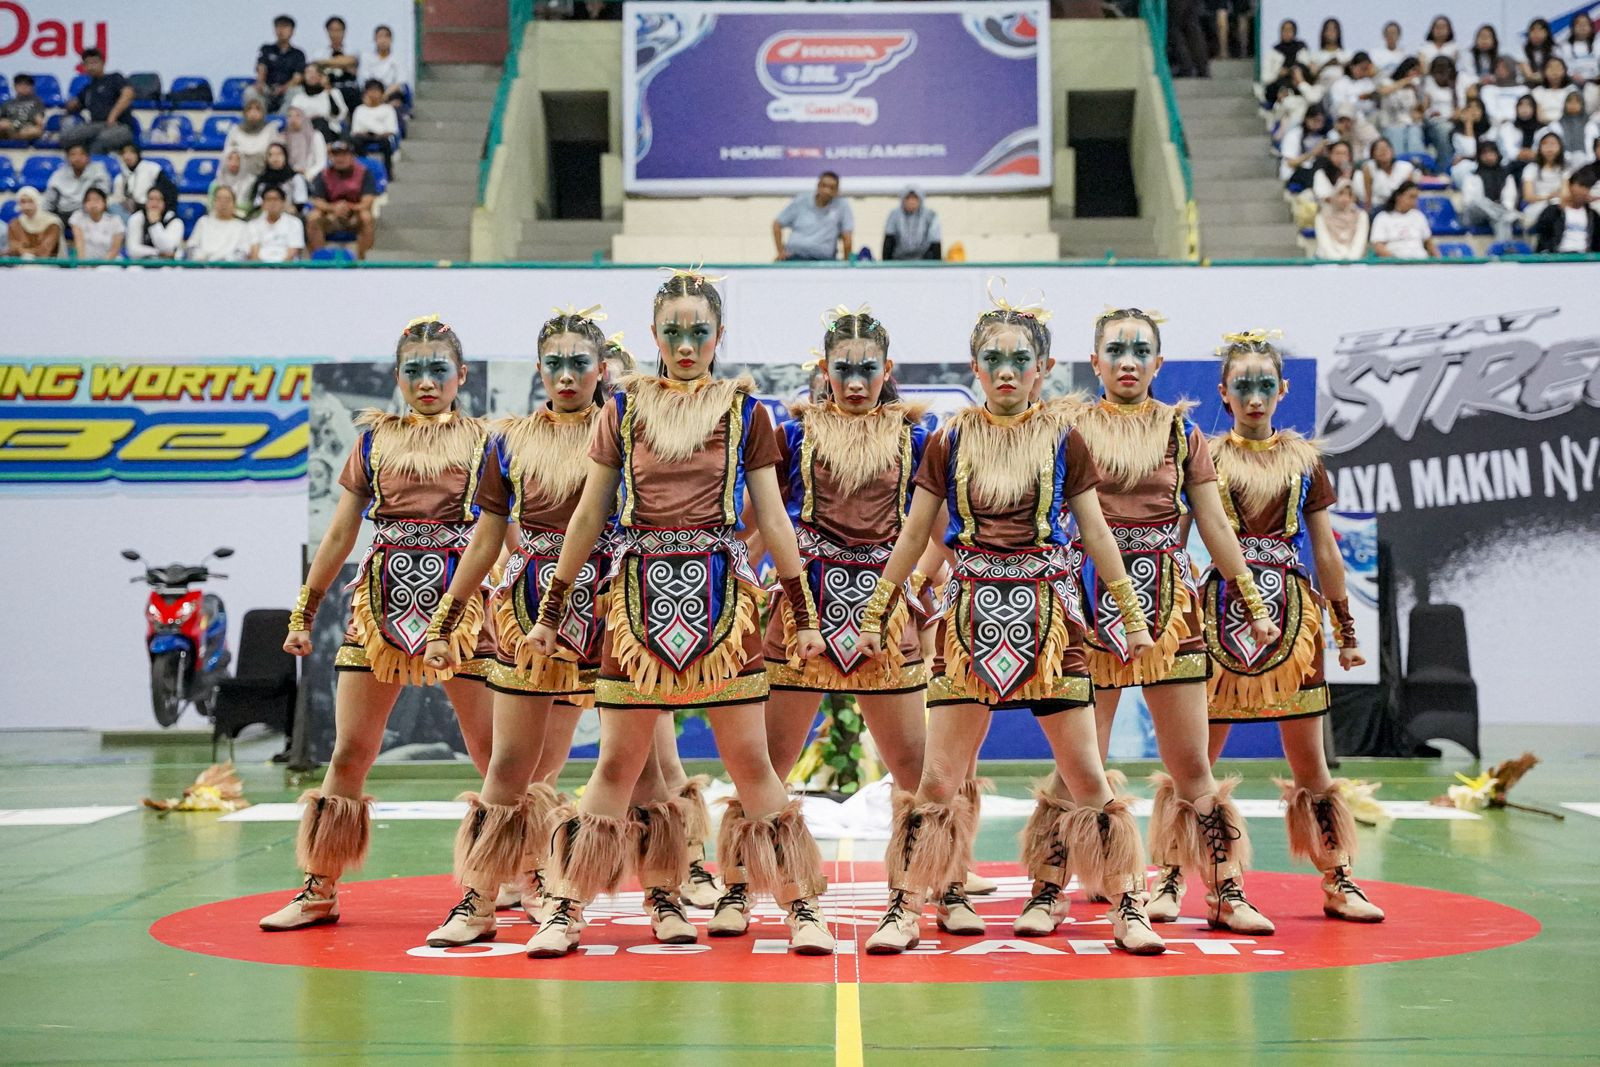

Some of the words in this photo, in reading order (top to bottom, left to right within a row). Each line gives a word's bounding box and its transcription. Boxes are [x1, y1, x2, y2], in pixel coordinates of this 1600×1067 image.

[0, 1, 107, 74] Day
[90, 363, 276, 400] WORTH
[1316, 338, 1600, 454] STRE
[1326, 461, 1402, 514] AYA
[1409, 447, 1533, 510] MAKIN
